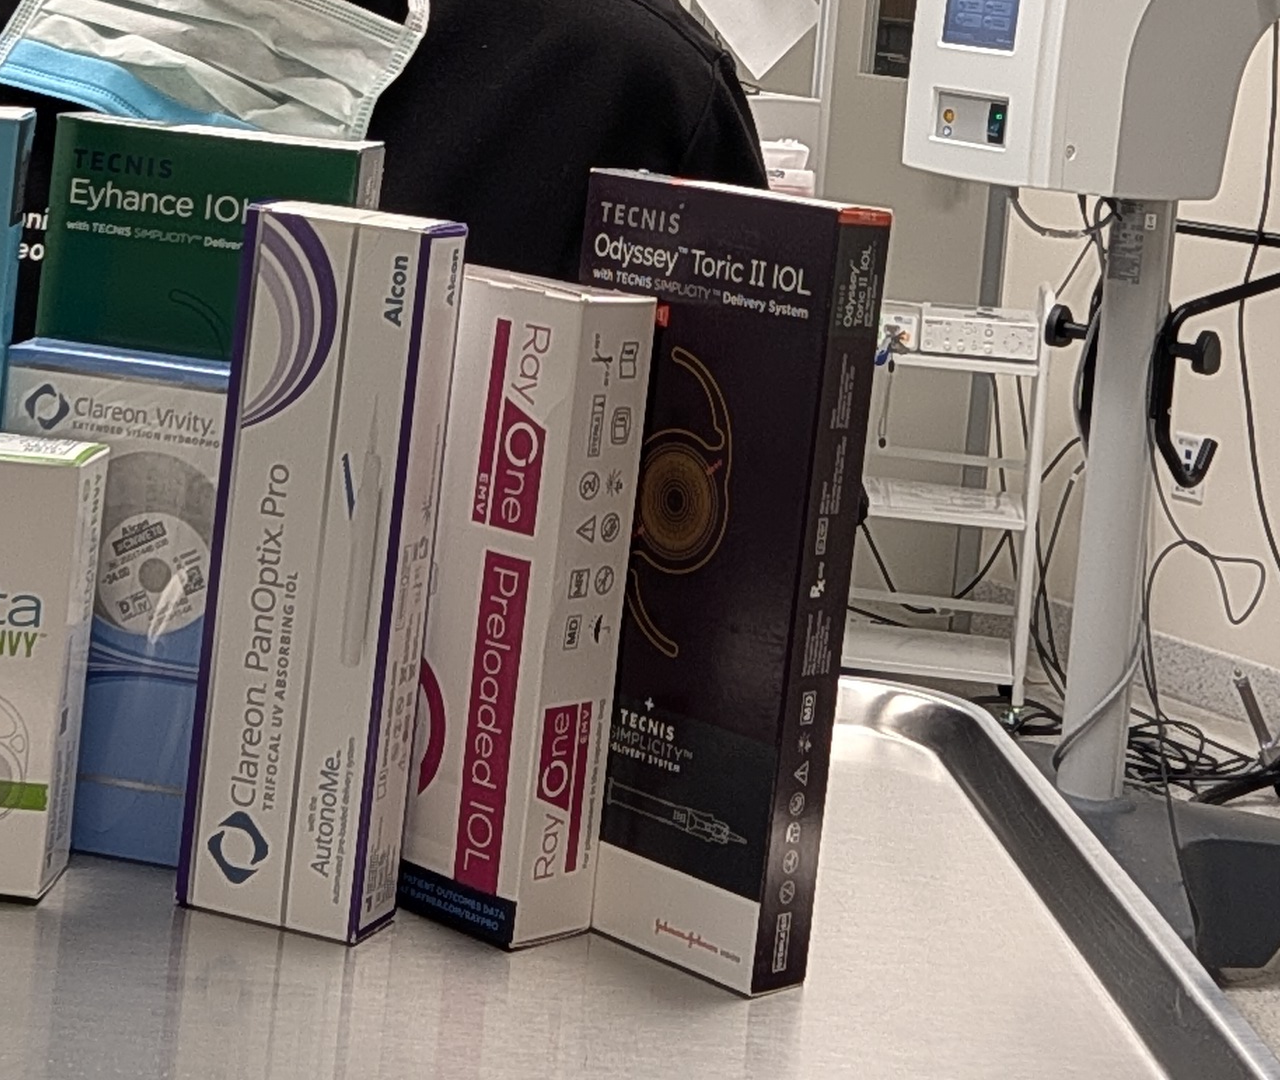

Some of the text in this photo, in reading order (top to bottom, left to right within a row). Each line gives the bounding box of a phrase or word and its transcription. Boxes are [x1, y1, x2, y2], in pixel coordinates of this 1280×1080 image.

[73, 148, 173, 179] TECNIS
[69, 177, 195, 219] Eyhance
[600, 201, 682, 235] TECNIS
[66, 220, 91, 233] with
[91, 221, 132, 238] TECNIS
[203, 235, 244, 251] Deliver
[383, 255, 410, 328] Alcon
[446, 248, 460, 307] Alcon
[592, 267, 614, 283] with
[616, 270, 653, 289] TECNIS
[722, 290, 768, 314] Delivery
[768, 299, 810, 320] System
[691, 248, 744, 284] Toric
[750, 258, 767, 288] II
[773, 265, 812, 297] IOL
[72, 420, 221, 450] EXTENDED VISION HYDROPHO
[260, 463, 290, 518] Pro
[475, 472, 490, 516] EMV
[244, 524, 285, 672] PanOptix
[262, 571, 299, 812] TRIFOCAL UV ABSORBING IOL
[463, 566, 520, 871] Preloaded IOL
[620, 707, 676, 742] TECNIS
[483, 903, 507, 921] DATA
